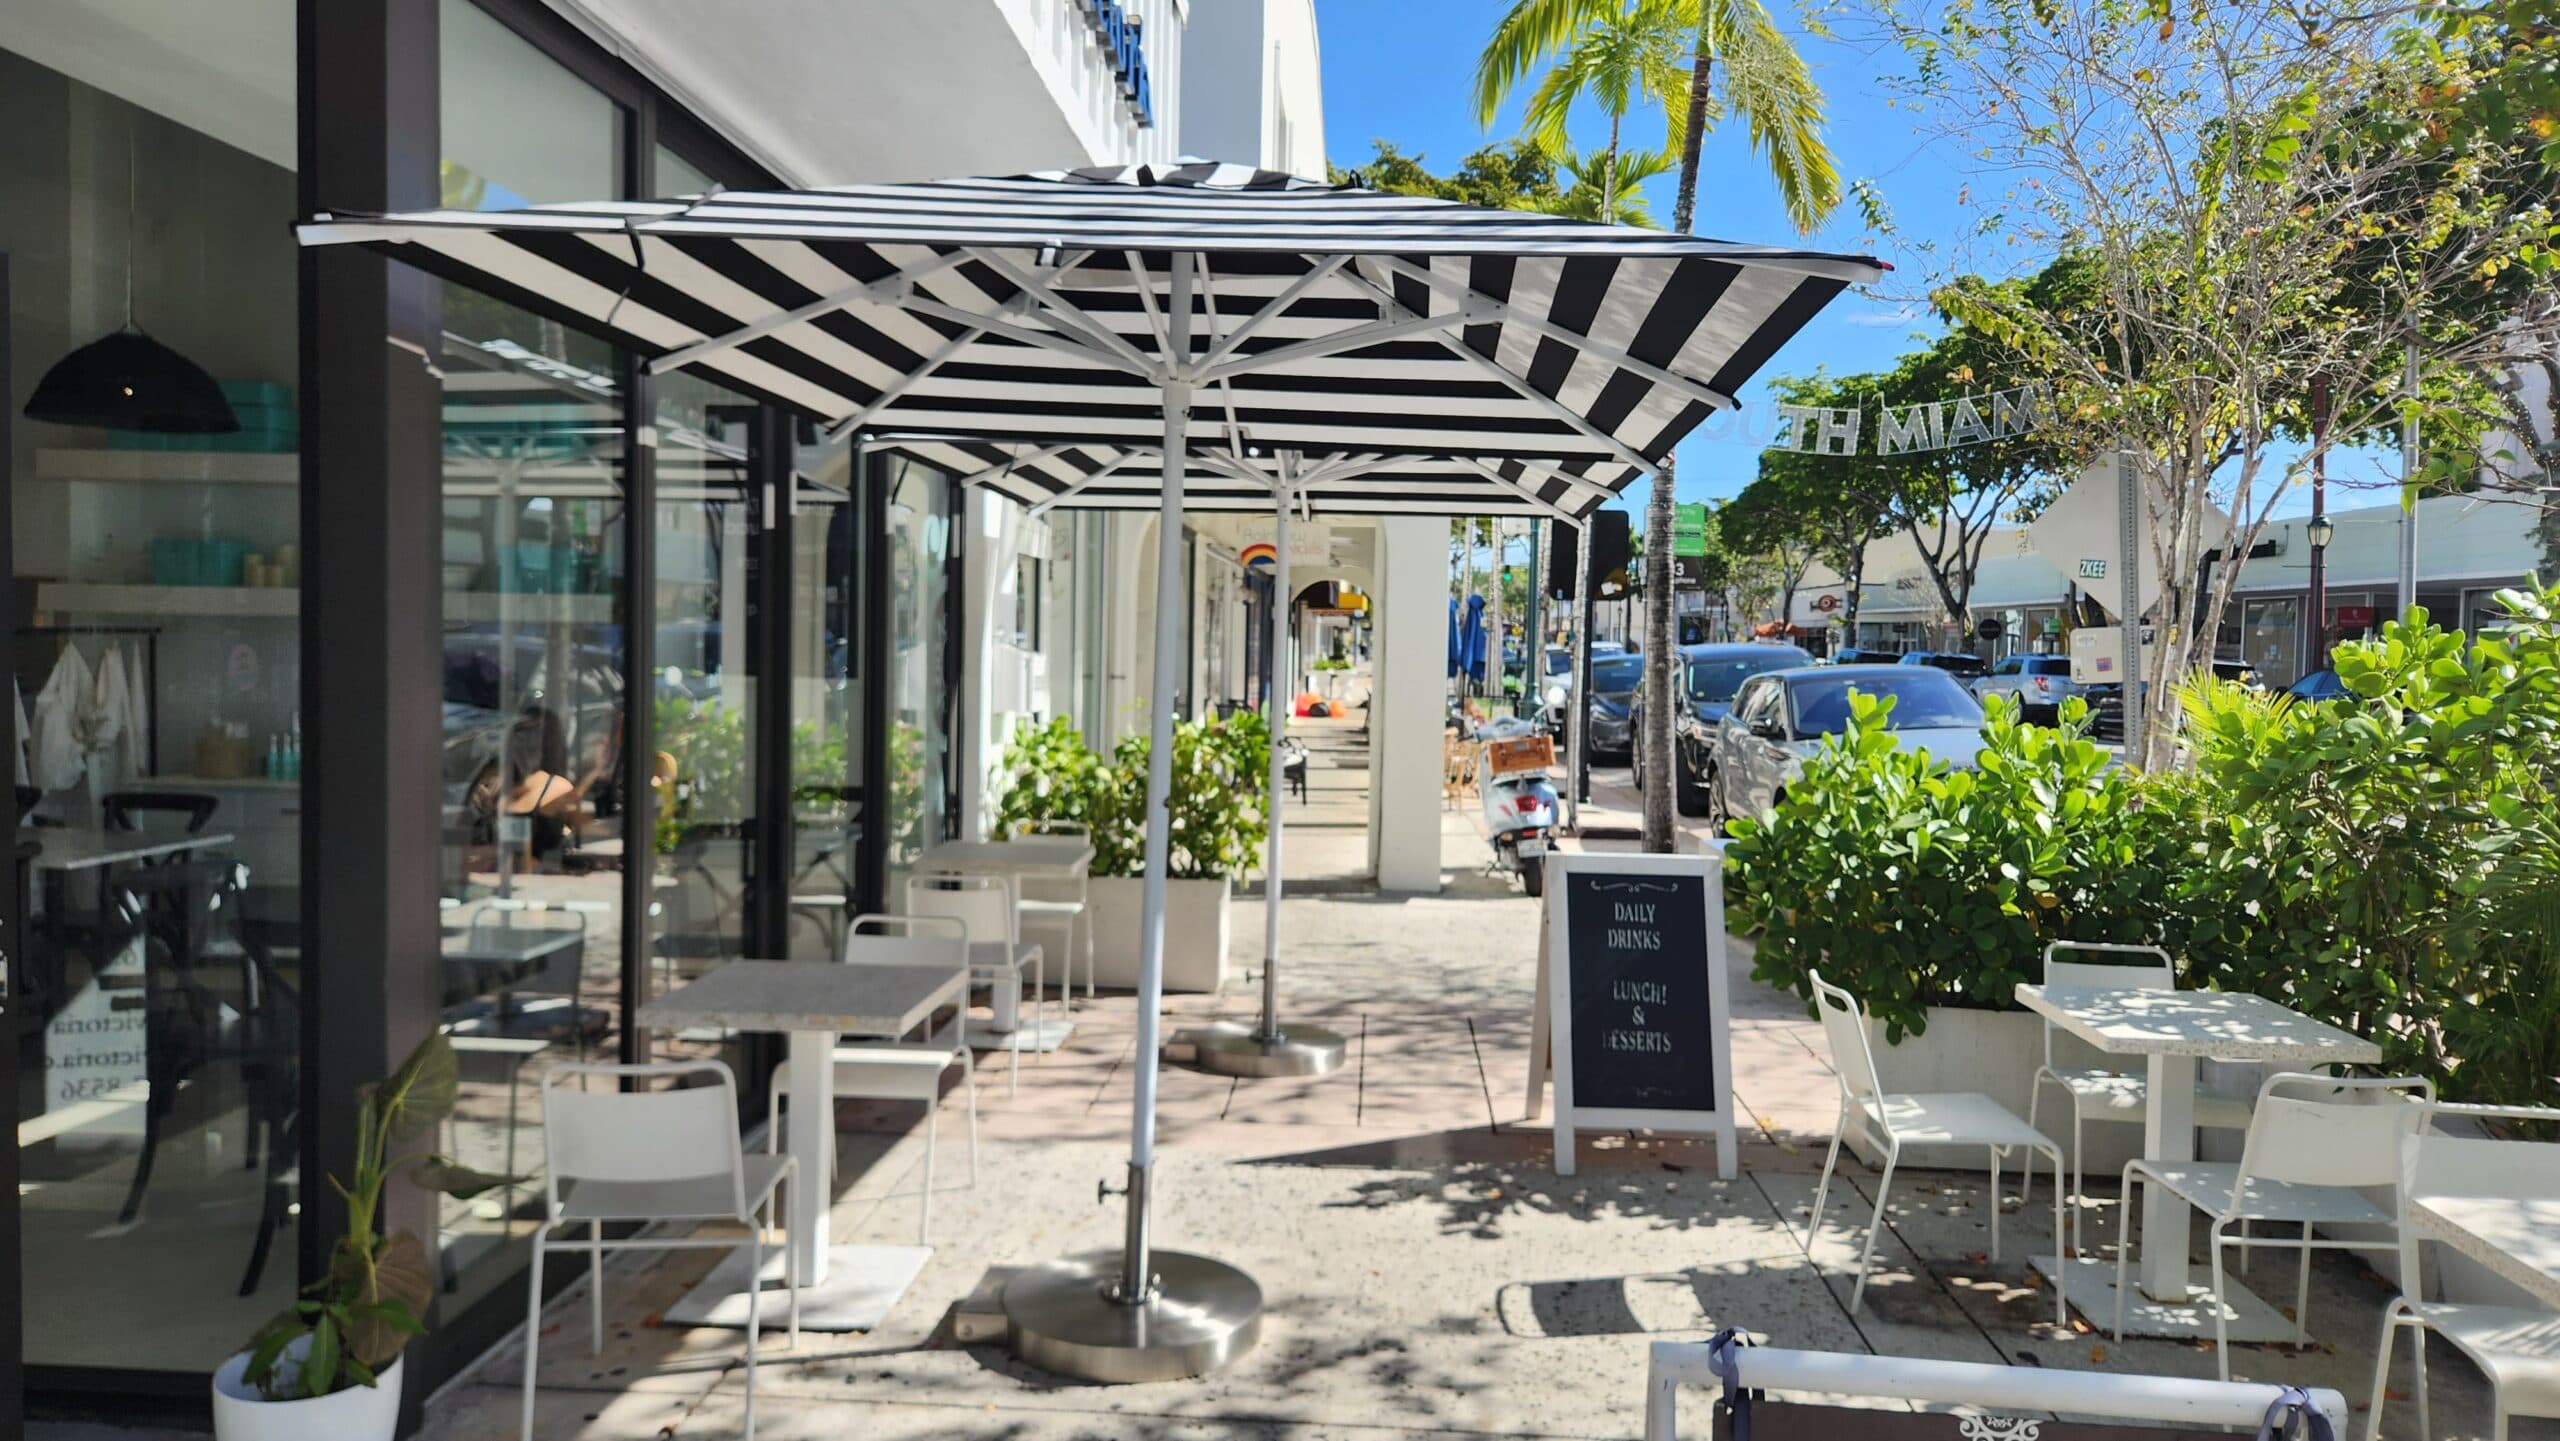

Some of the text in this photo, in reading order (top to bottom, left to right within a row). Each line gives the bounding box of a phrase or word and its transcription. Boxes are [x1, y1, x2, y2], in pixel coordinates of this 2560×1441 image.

[1614, 902, 1656, 924] DAILY
[1608, 929, 1661, 950] DRINKS
[1613, 980, 1667, 1006] LUNCH!
[1632, 1005, 1645, 1026] &
